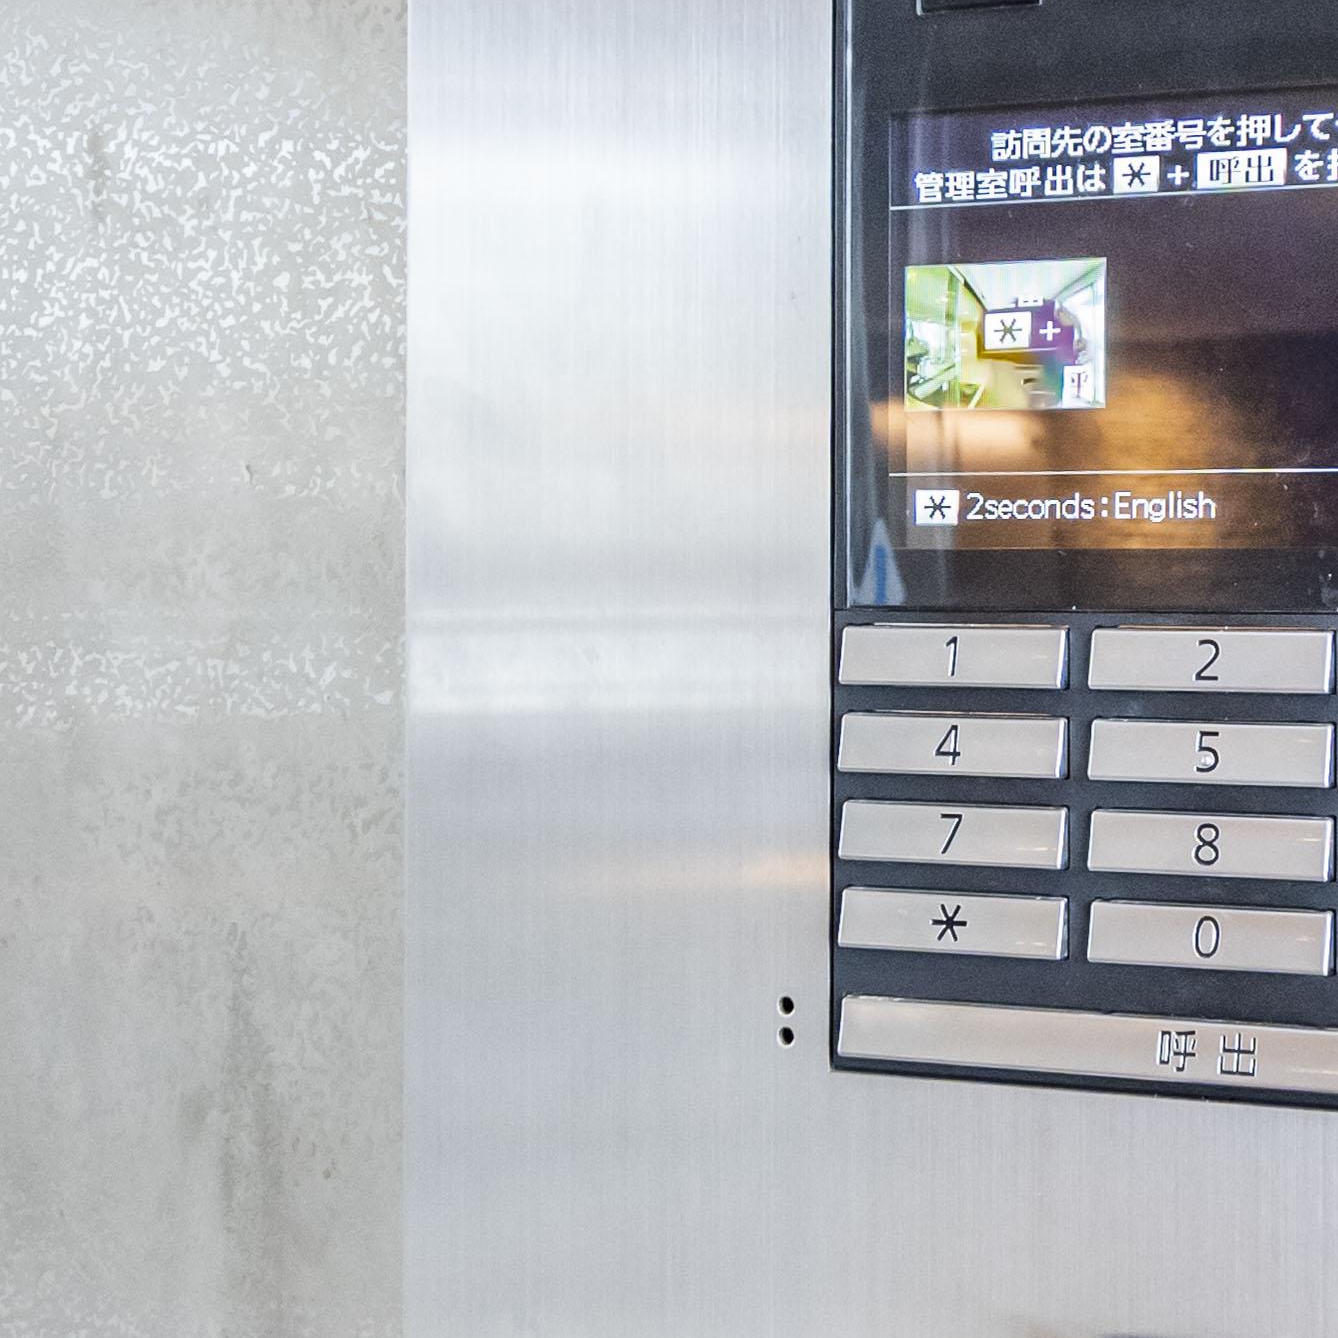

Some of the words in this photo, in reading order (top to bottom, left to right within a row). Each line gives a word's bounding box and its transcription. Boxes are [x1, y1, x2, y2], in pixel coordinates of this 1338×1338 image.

[914, 164, 1107, 204] 管理室呼出は
[945, 637, 958, 678] 1
[1196, 639, 1220, 682] 2
[934, 724, 961, 766] 4
[1196, 730, 1220, 774] 5
[940, 813, 963, 856] 7
[1195, 823, 1220, 867] 8
[1194, 915, 1220, 959] 0
